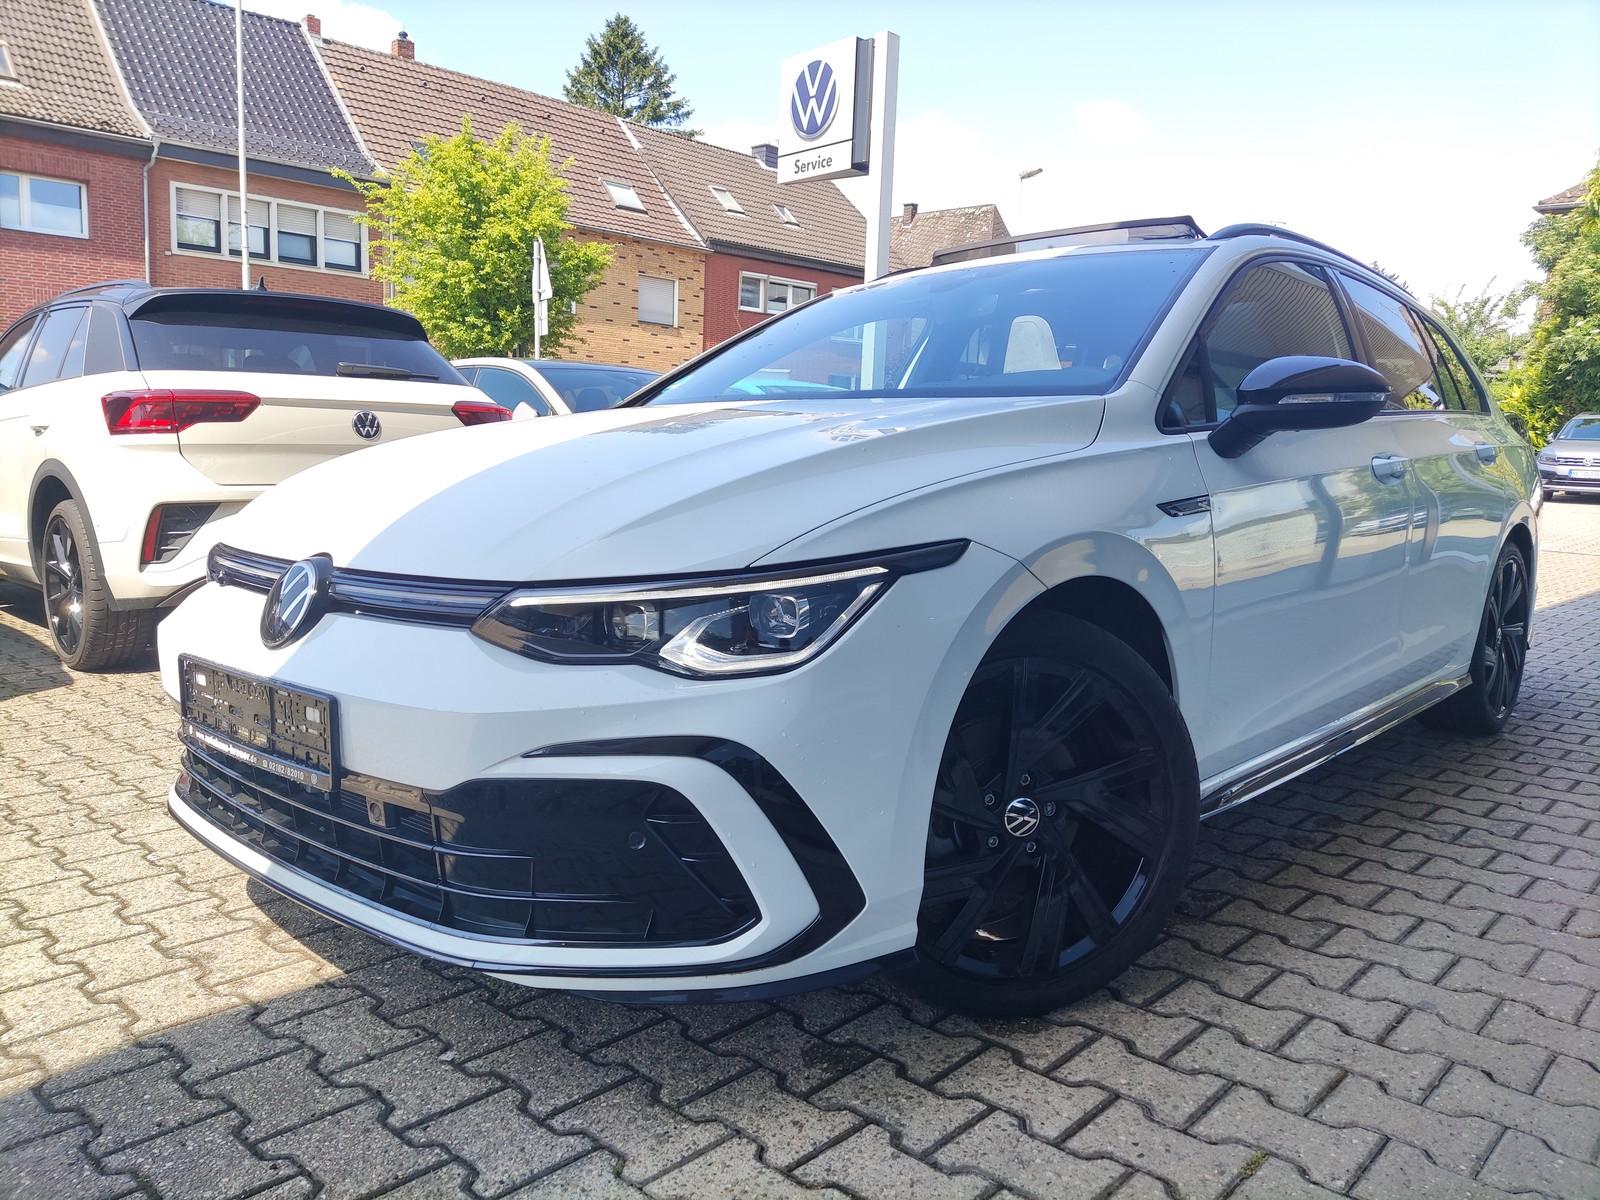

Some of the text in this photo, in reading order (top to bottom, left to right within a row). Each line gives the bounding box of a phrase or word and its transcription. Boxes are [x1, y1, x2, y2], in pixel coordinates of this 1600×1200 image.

[790, 58, 838, 138] VW
[793, 155, 833, 174] Service
[353, 411, 381, 440] VW
